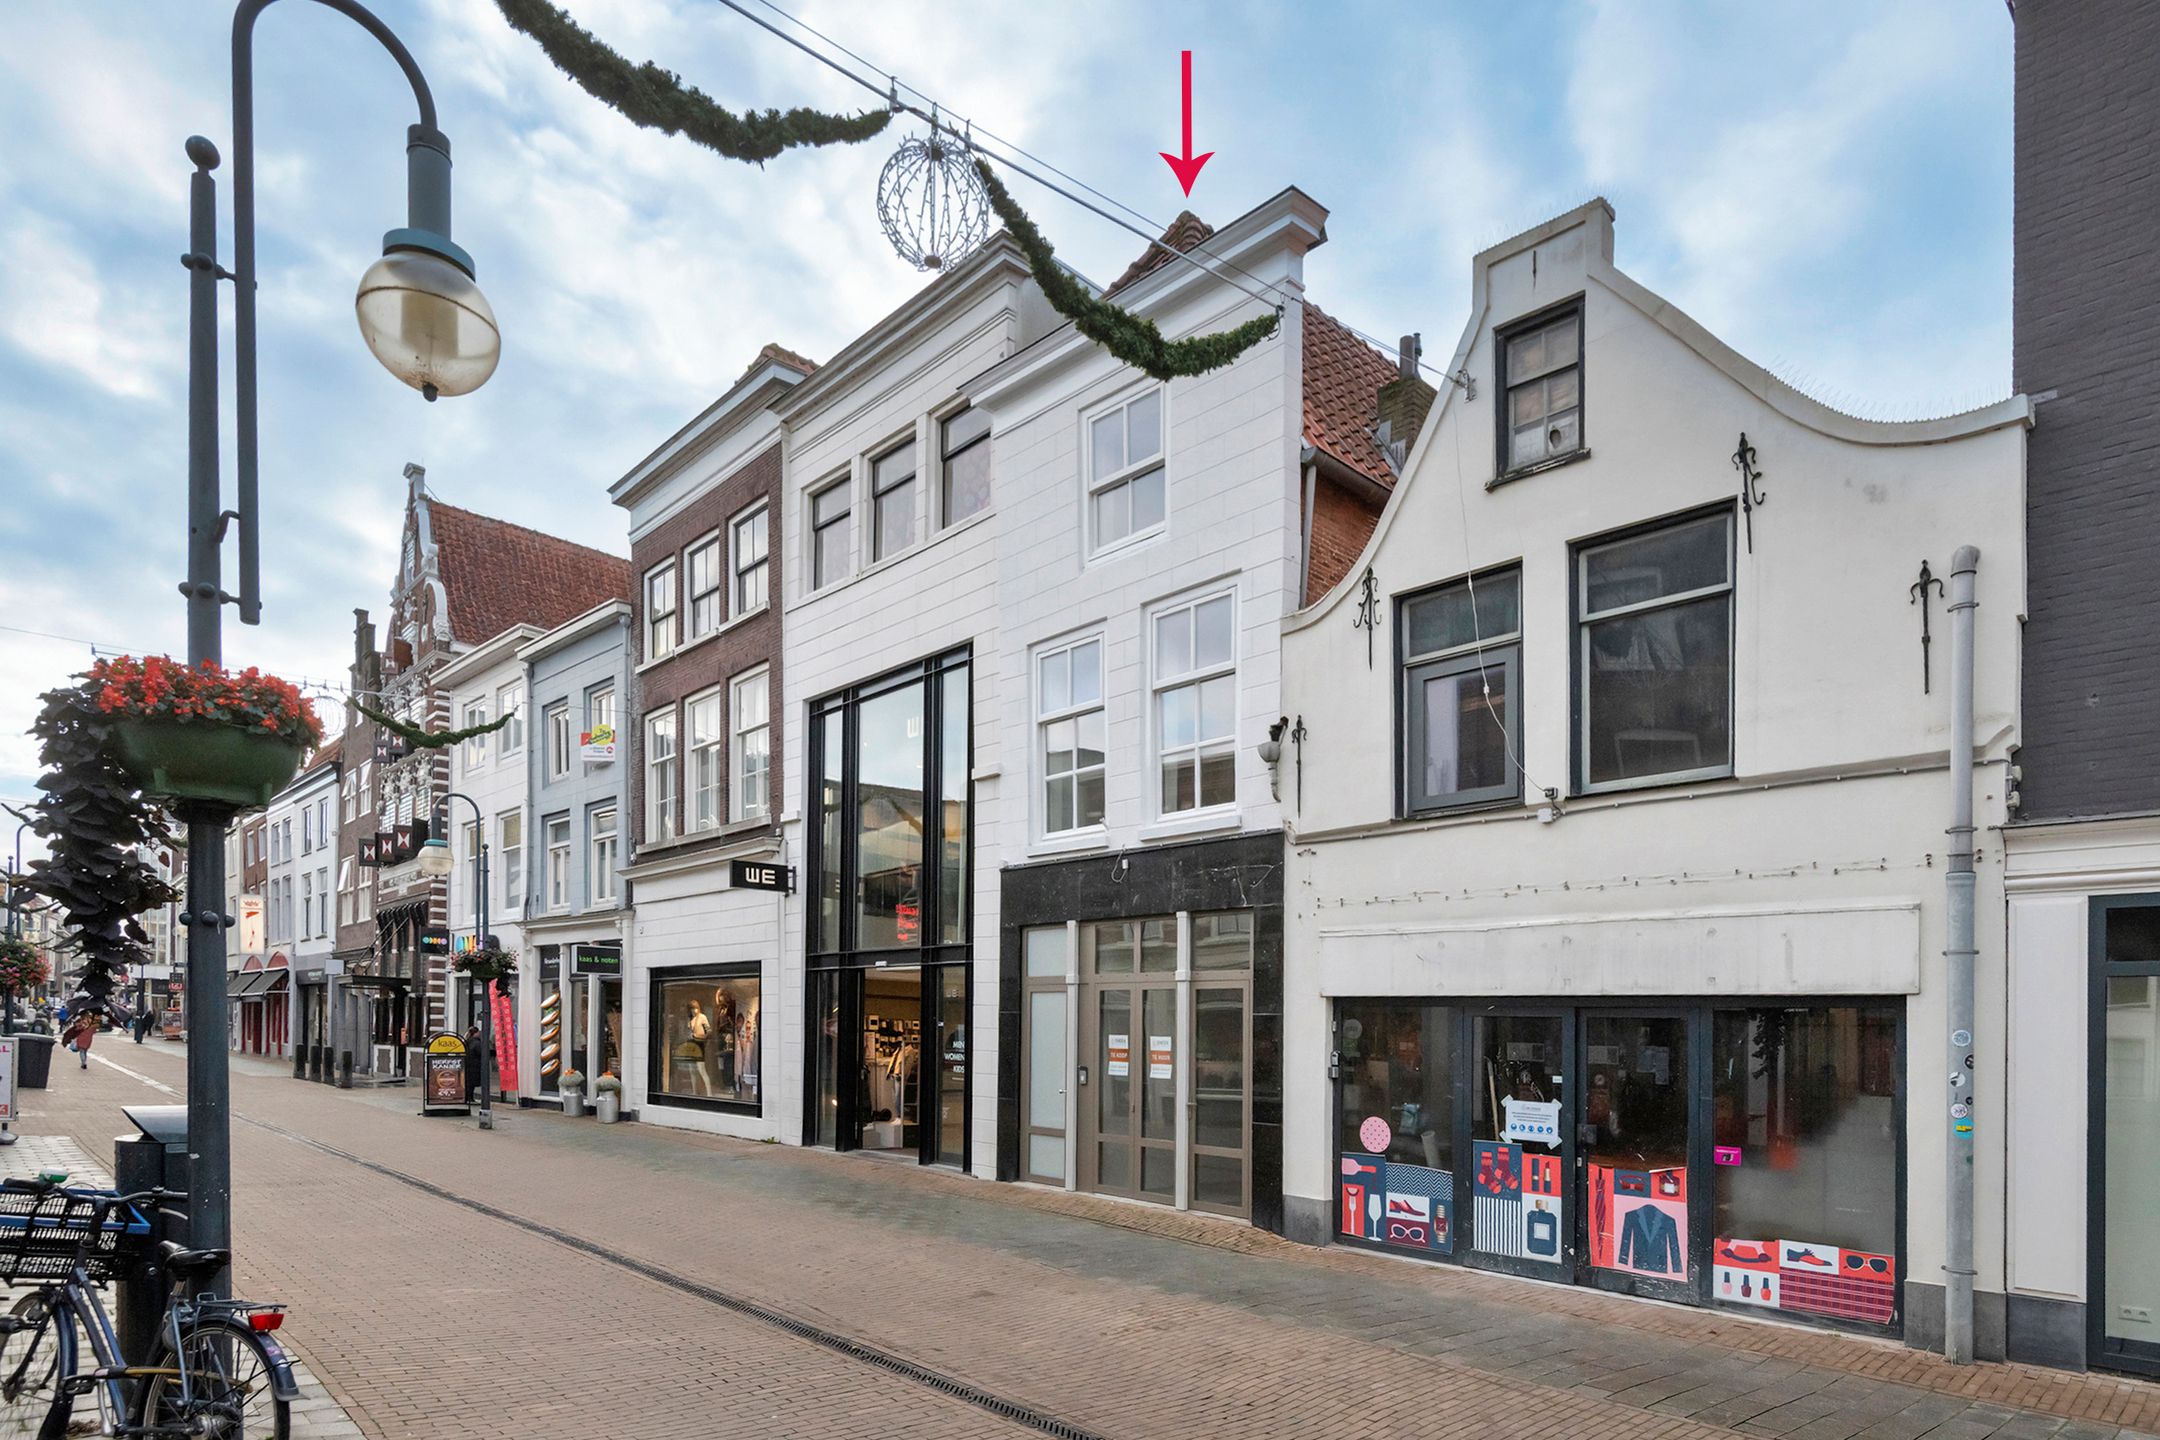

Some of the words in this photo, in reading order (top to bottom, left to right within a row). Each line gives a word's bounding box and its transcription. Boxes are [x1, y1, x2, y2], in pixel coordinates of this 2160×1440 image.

[745, 867, 776, 885] WE
[578, 955, 593, 963] kaas
[438, 1039, 457, 1047] kaas
[952, 1040, 965, 1049] MEN
[943, 1053, 965, 1061] WOMEN
[953, 1065, 965, 1074] KIDS
